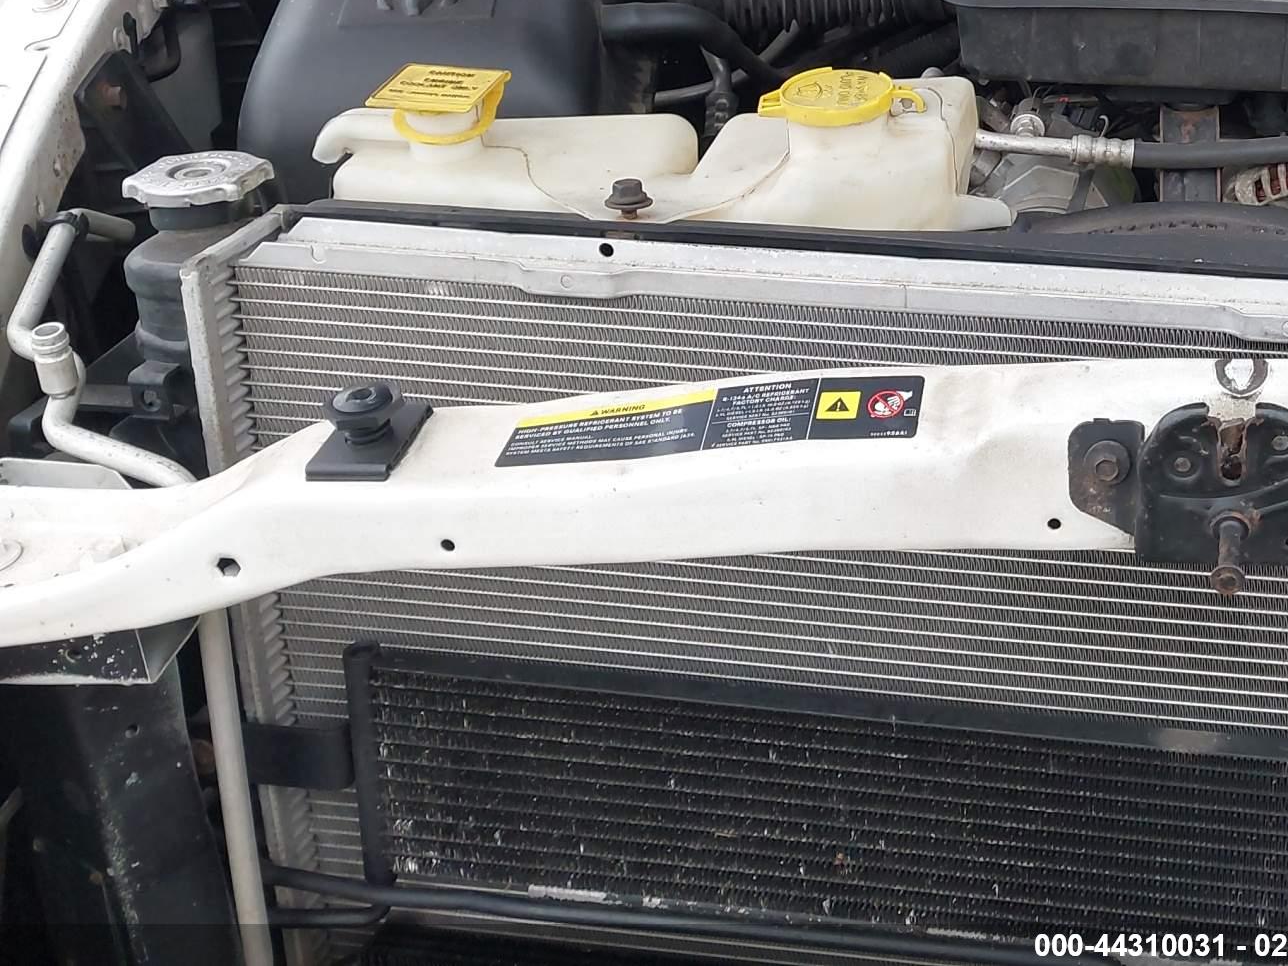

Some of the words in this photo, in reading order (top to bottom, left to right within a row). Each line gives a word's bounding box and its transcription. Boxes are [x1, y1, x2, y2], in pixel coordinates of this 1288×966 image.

[400, 81, 447, 89] COOLANT
[743, 384, 792, 393] ATTENTION
[761, 389, 810, 398] REFRIGERANT
[601, 405, 646, 414] WARNING
[518, 424, 577, 435] HIGH-PRESSURE
[579, 417, 629, 427] REFRIGERANT
[631, 414, 660, 422] SYSTEM
[726, 420, 775, 428] COMPRESSOR
[514, 432, 551, 440] SERVICED
[563, 426, 603, 434] QUALIFIED
[604, 422, 648, 430] PERSONNEL
